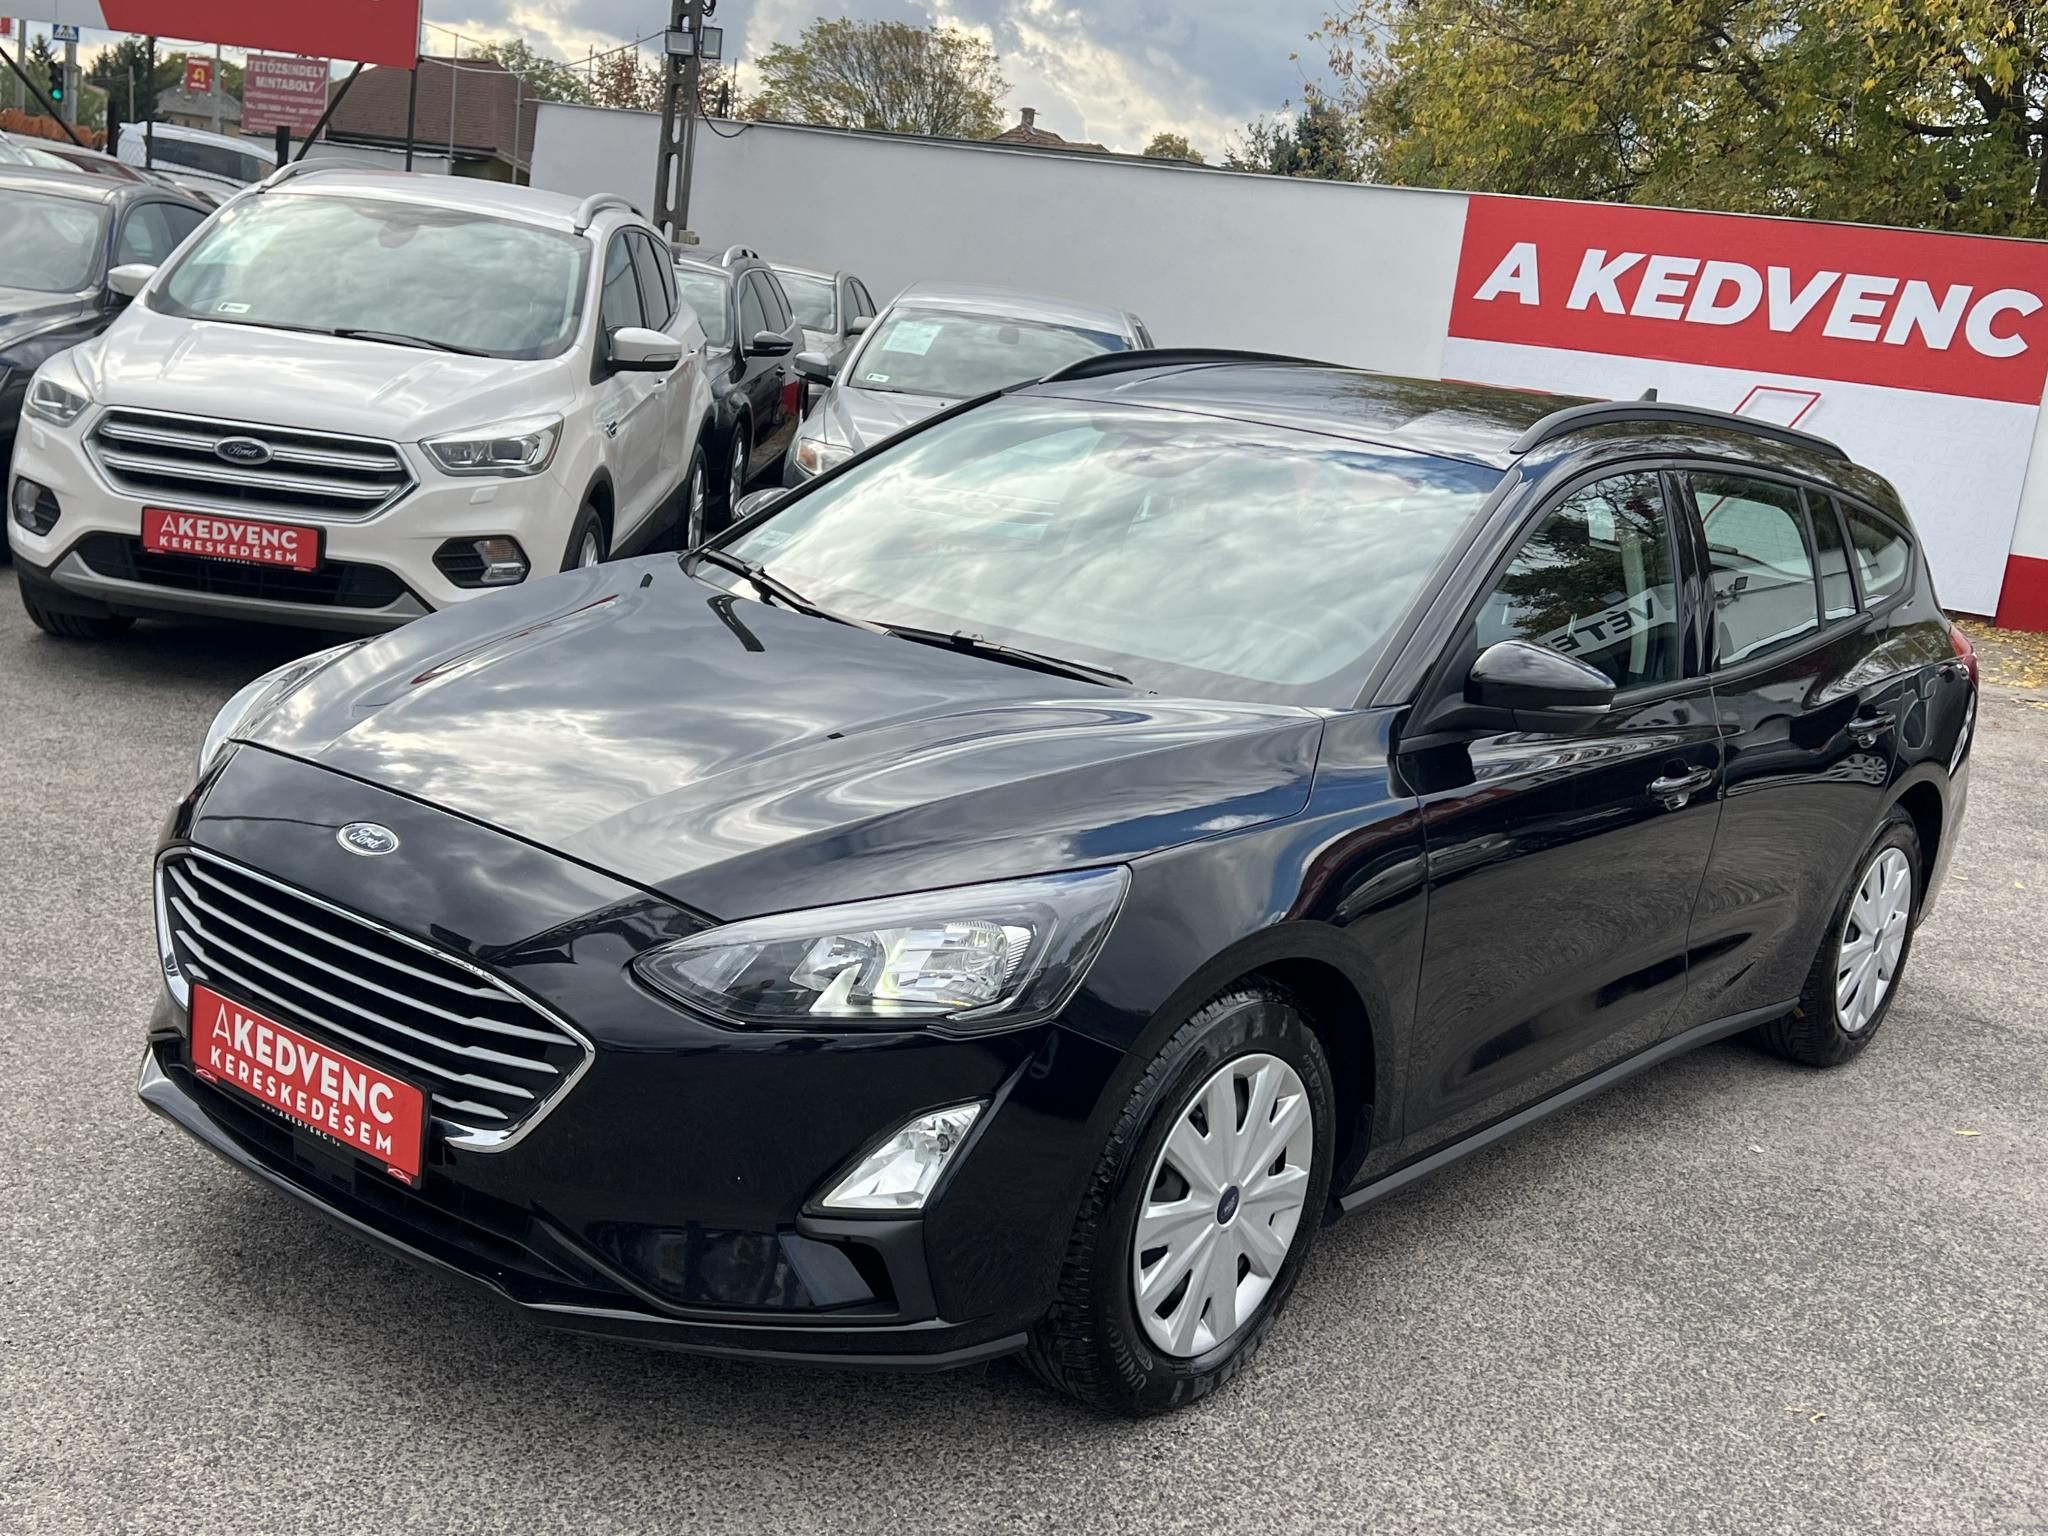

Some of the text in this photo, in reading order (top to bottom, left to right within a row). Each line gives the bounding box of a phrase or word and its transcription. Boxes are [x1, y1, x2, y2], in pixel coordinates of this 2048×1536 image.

[256, 76, 316, 93] MINTABOLT
[1473, 242, 2044, 358] A KEDVENC
[159, 536, 298, 563] KERESKEDÉSEM
[210, 1045, 393, 1156] KERESKEDÉSEM
